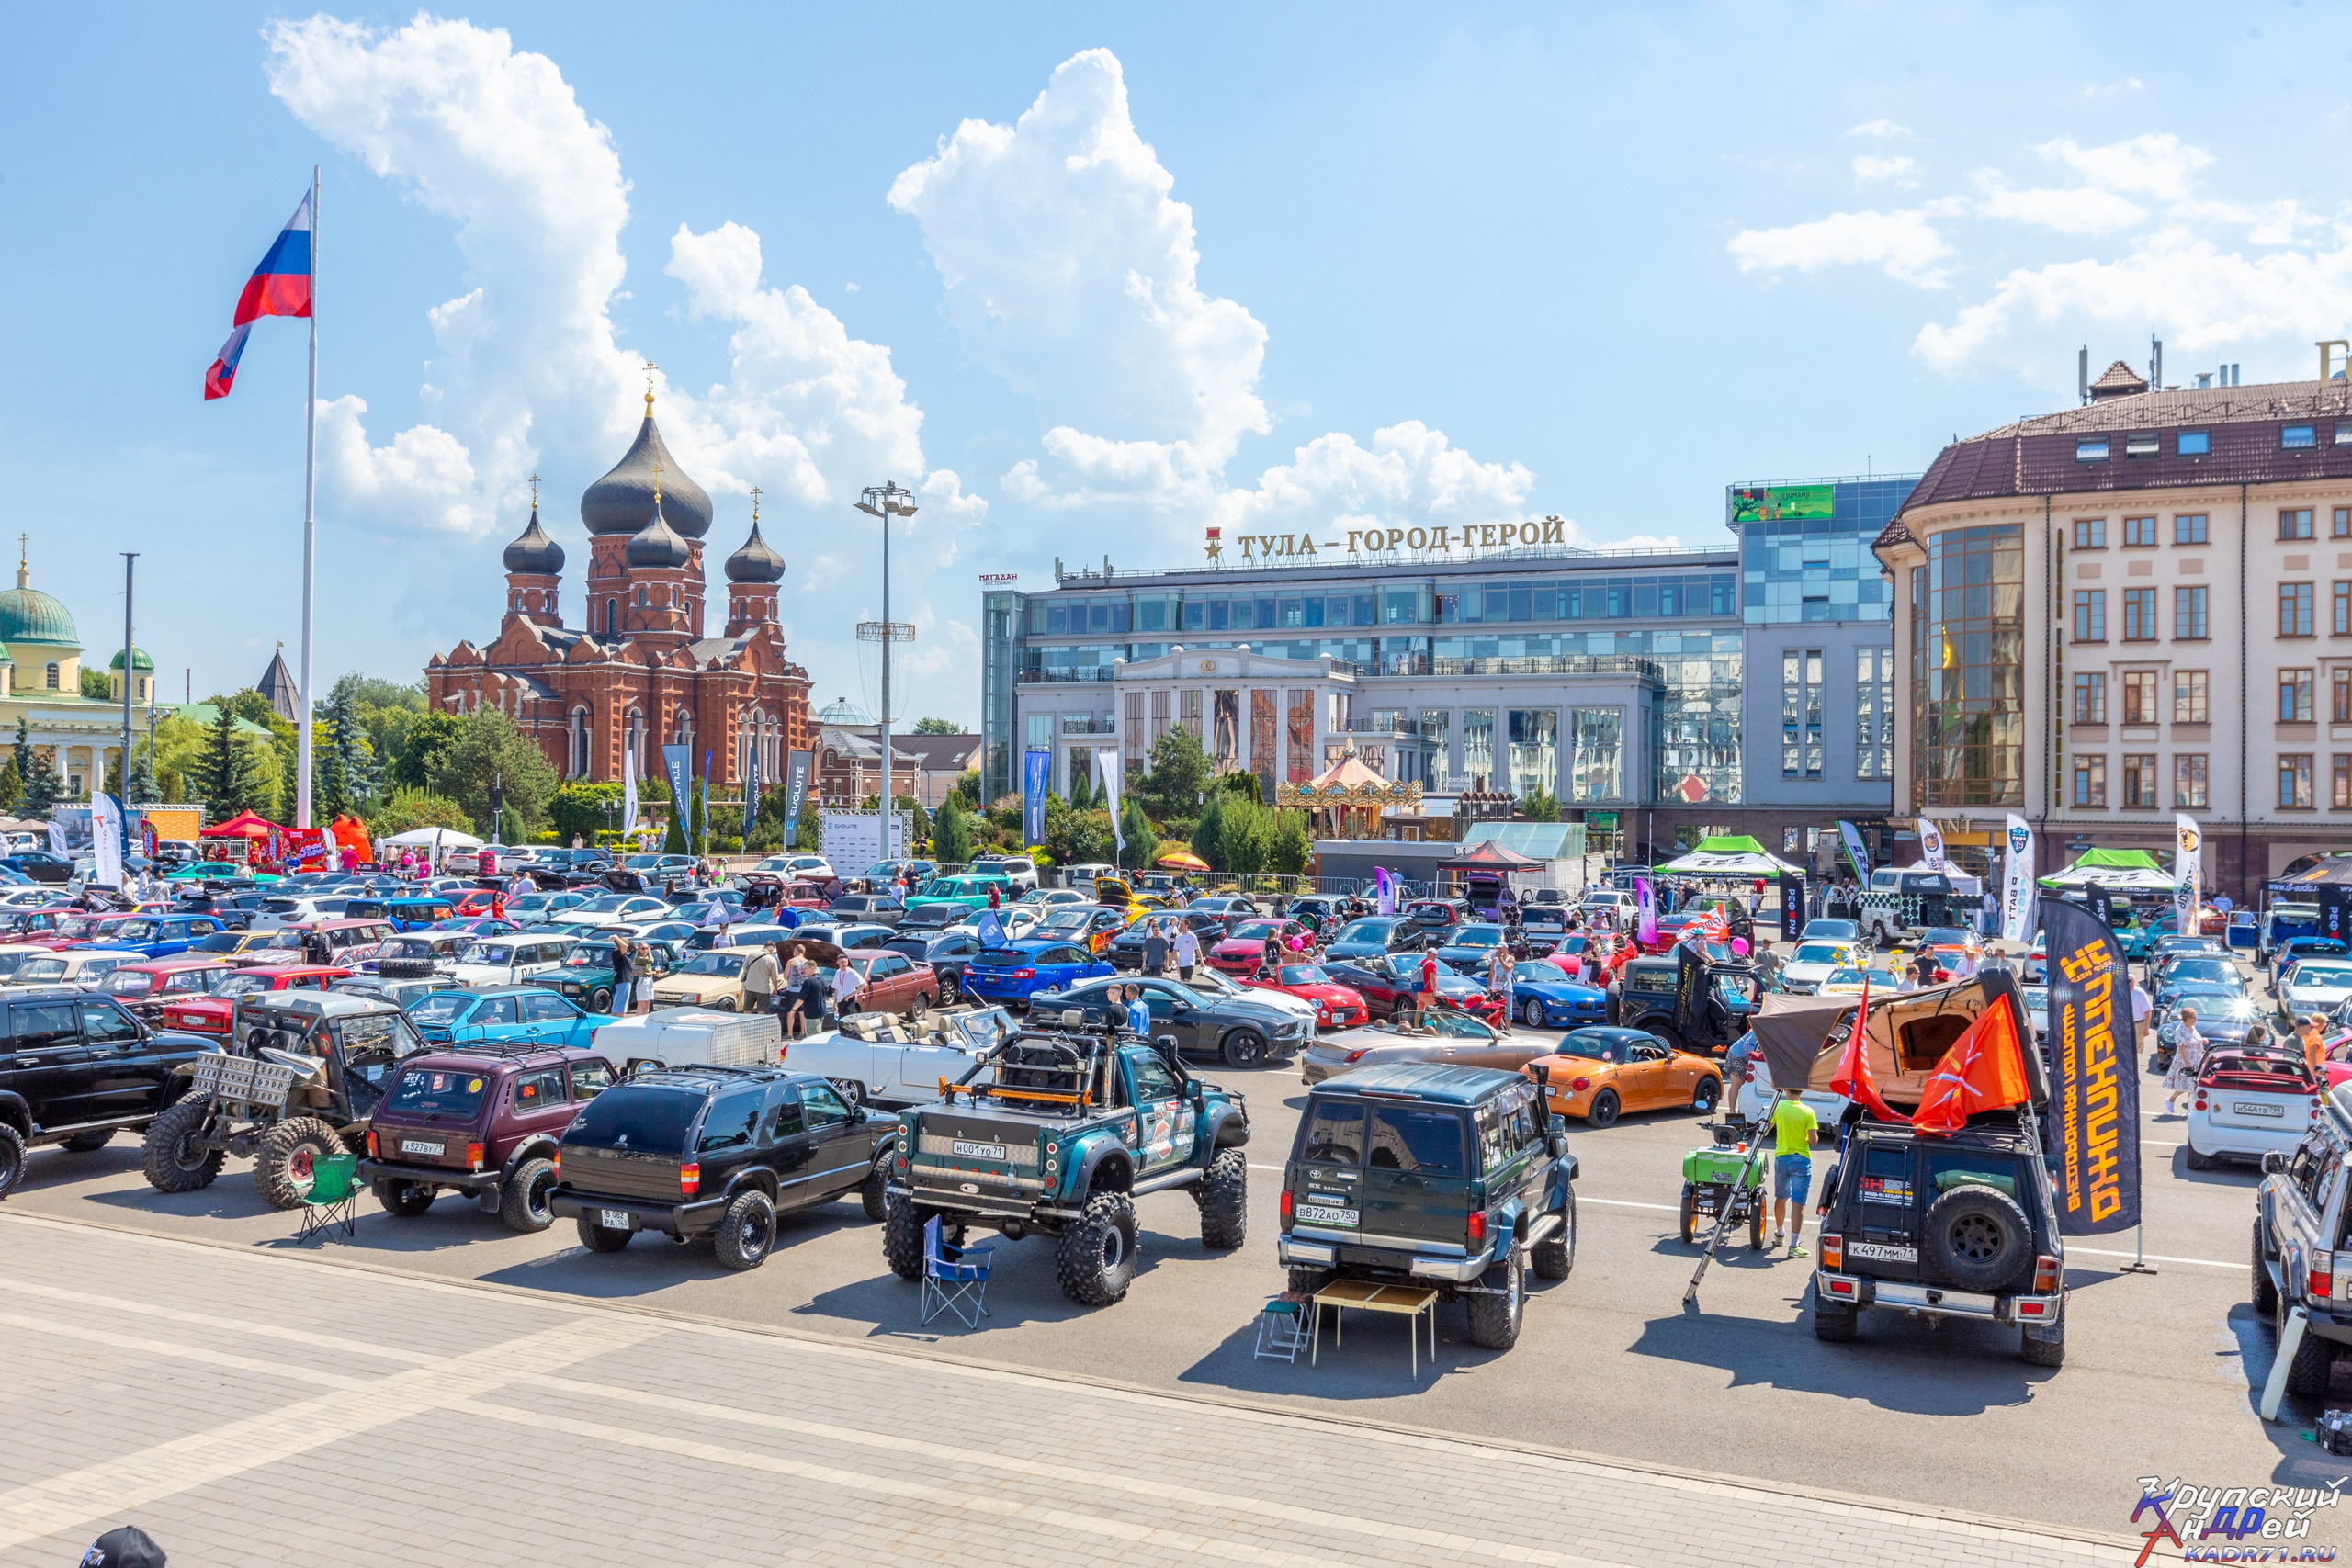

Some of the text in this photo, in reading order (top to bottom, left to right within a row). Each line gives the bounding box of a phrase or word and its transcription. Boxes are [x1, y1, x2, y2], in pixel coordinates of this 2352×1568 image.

[1238, 533, 1317, 558] ТУЛА
[1347, 515, 1565, 554] ГОРОД-ГЕРОЙ
[790, 765, 805, 817] EVOLUTE
[244, 1011, 266, 1021] YAMA
[282, 1016, 300, 1025] MIKA
[2237, 1106, 2267, 1114] Н544ТВ
[404, 1142, 433, 1153] Х527ВУ
[956, 1144, 1001, 1156] Н001УО 71
[1299, 1207, 1356, 1221] В872АО 750
[1853, 1245, 1914, 1258] К497ММ 71
